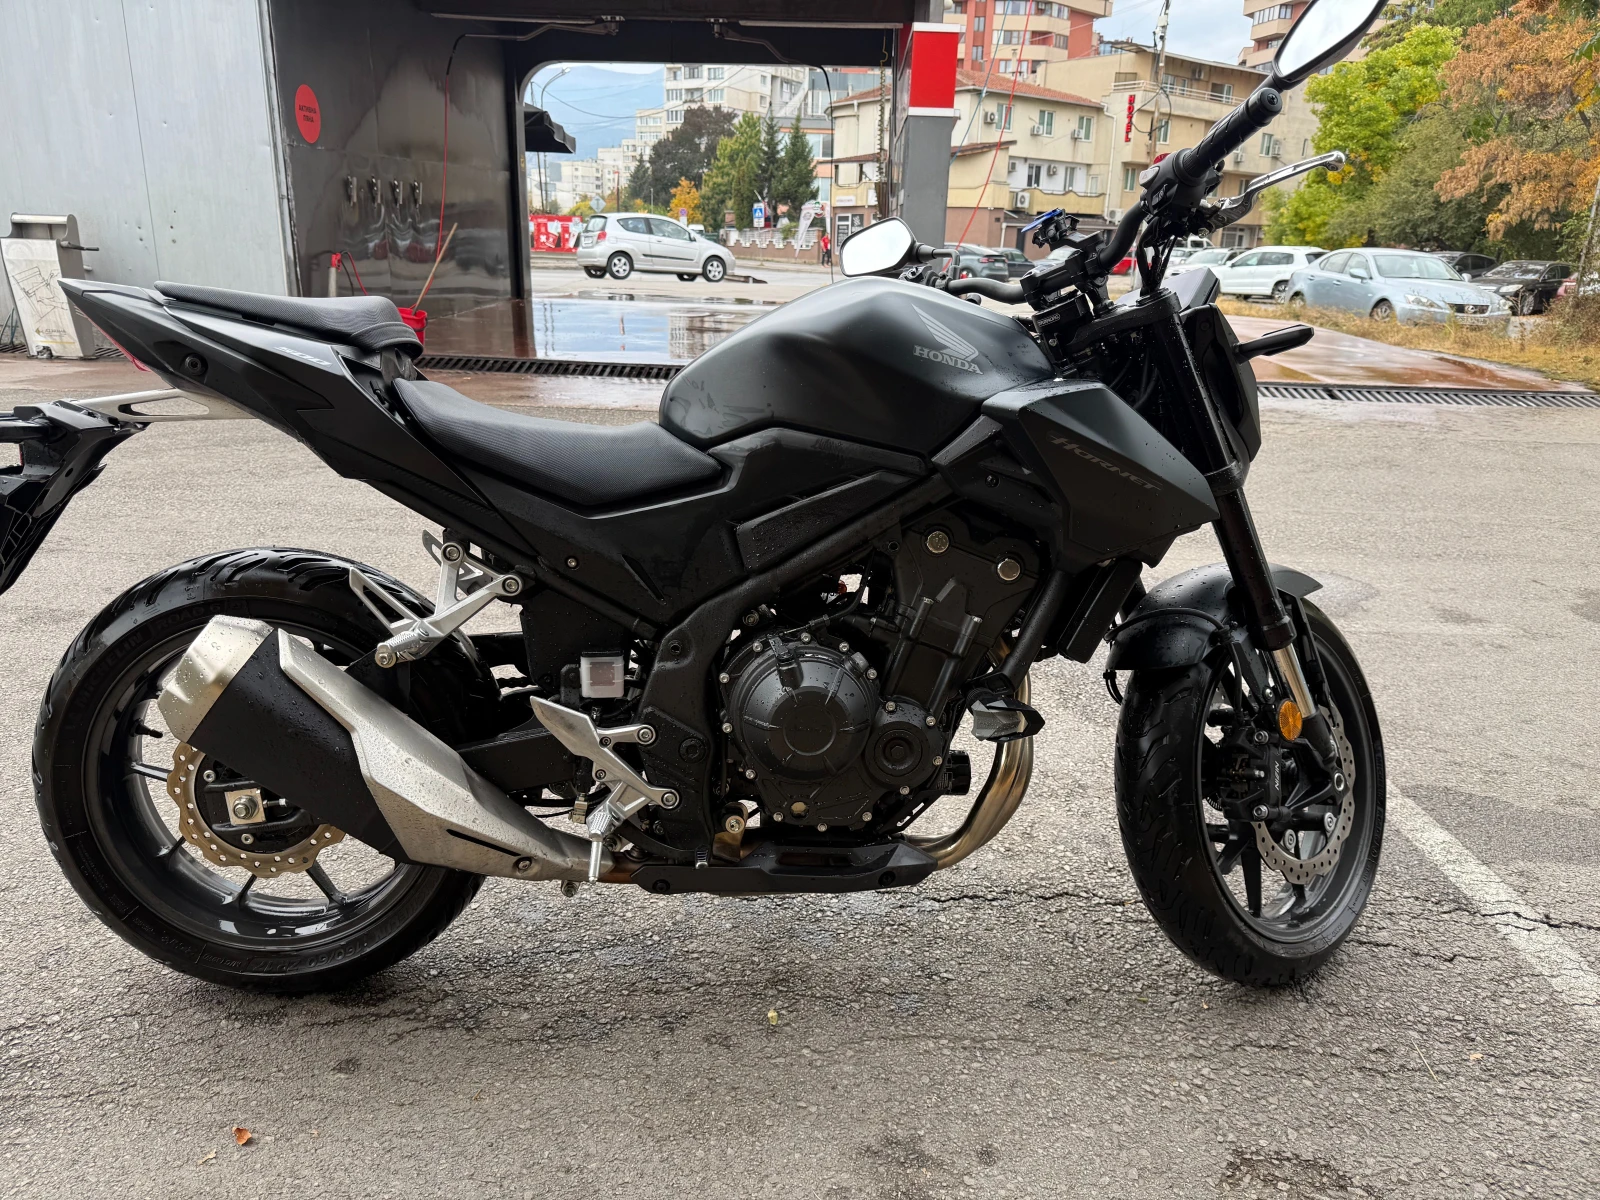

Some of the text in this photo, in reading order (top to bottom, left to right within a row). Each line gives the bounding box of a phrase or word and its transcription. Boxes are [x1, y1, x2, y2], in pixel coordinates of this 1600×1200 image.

[298, 104, 317, 114] АКТИВНА
[1124, 94, 1136, 143] HOTEL
[913, 344, 983, 375] HONDA
[1047, 431, 1163, 491] HORNET
[306, 940, 363, 968] 160/60
